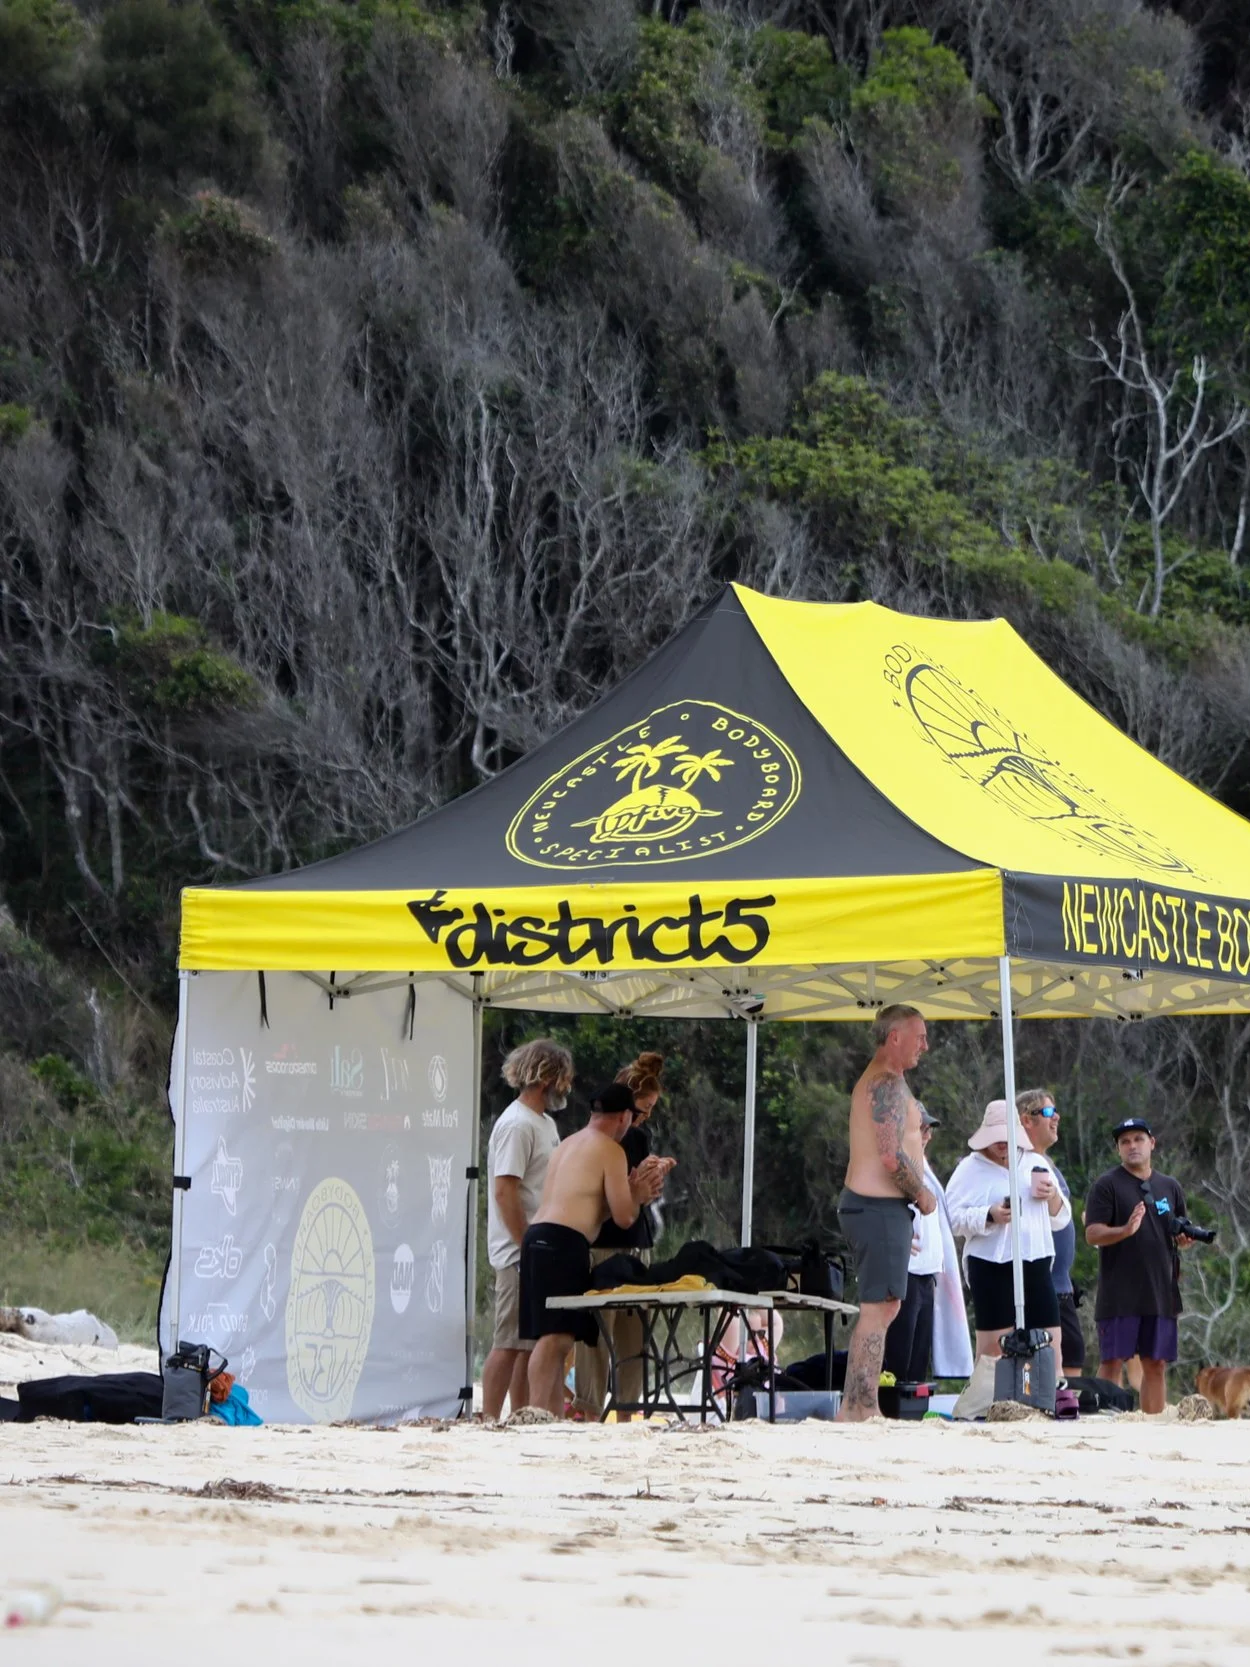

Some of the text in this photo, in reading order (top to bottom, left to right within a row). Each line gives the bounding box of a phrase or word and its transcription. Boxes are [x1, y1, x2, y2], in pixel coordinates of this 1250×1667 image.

[711, 716, 781, 822] BODYBOARD
[539, 831, 728, 862] SPECIALIST
[445, 893, 777, 968] district5
[1061, 881, 1214, 970] NEWCASTLE
